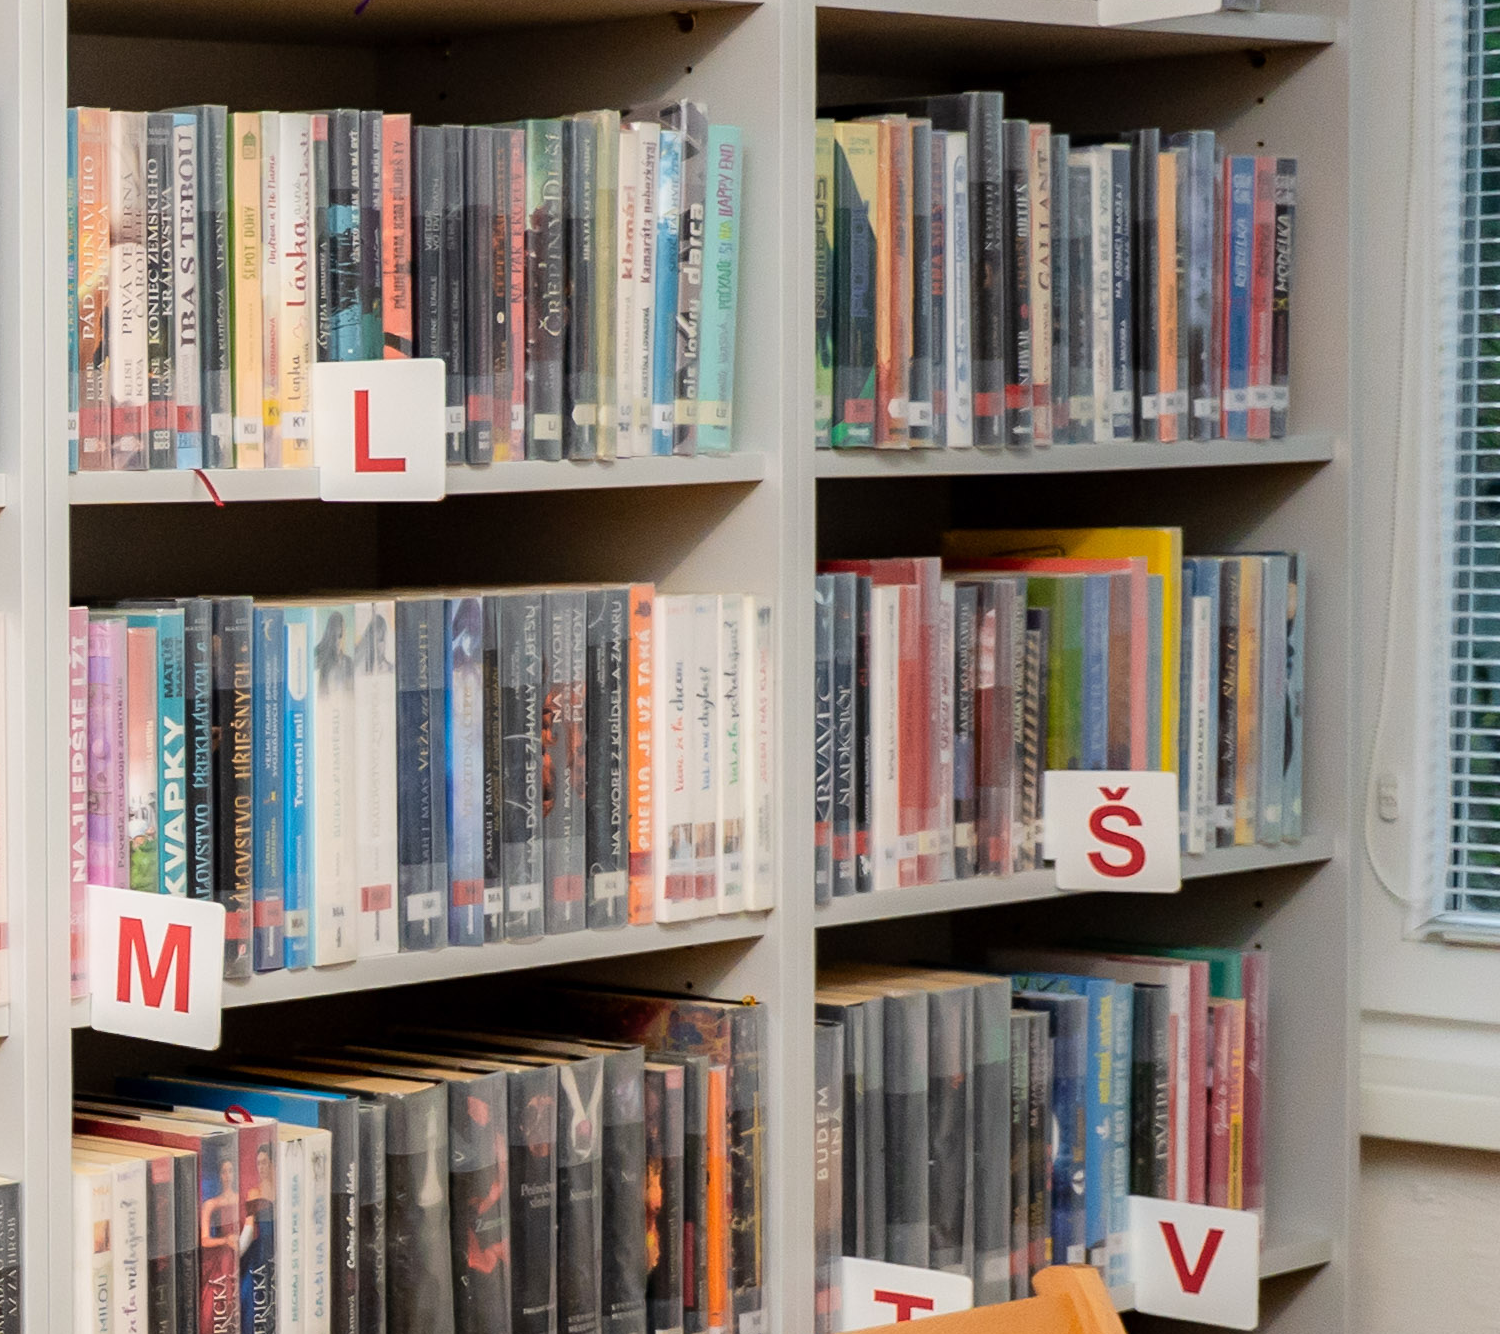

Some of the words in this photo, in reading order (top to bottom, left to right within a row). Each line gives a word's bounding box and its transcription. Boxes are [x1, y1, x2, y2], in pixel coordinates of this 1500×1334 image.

[355, 389, 406, 473] L
[1088, 787, 1147, 878] Š
[116, 916, 193, 1013] M
[1159, 1221, 1225, 1294] V
